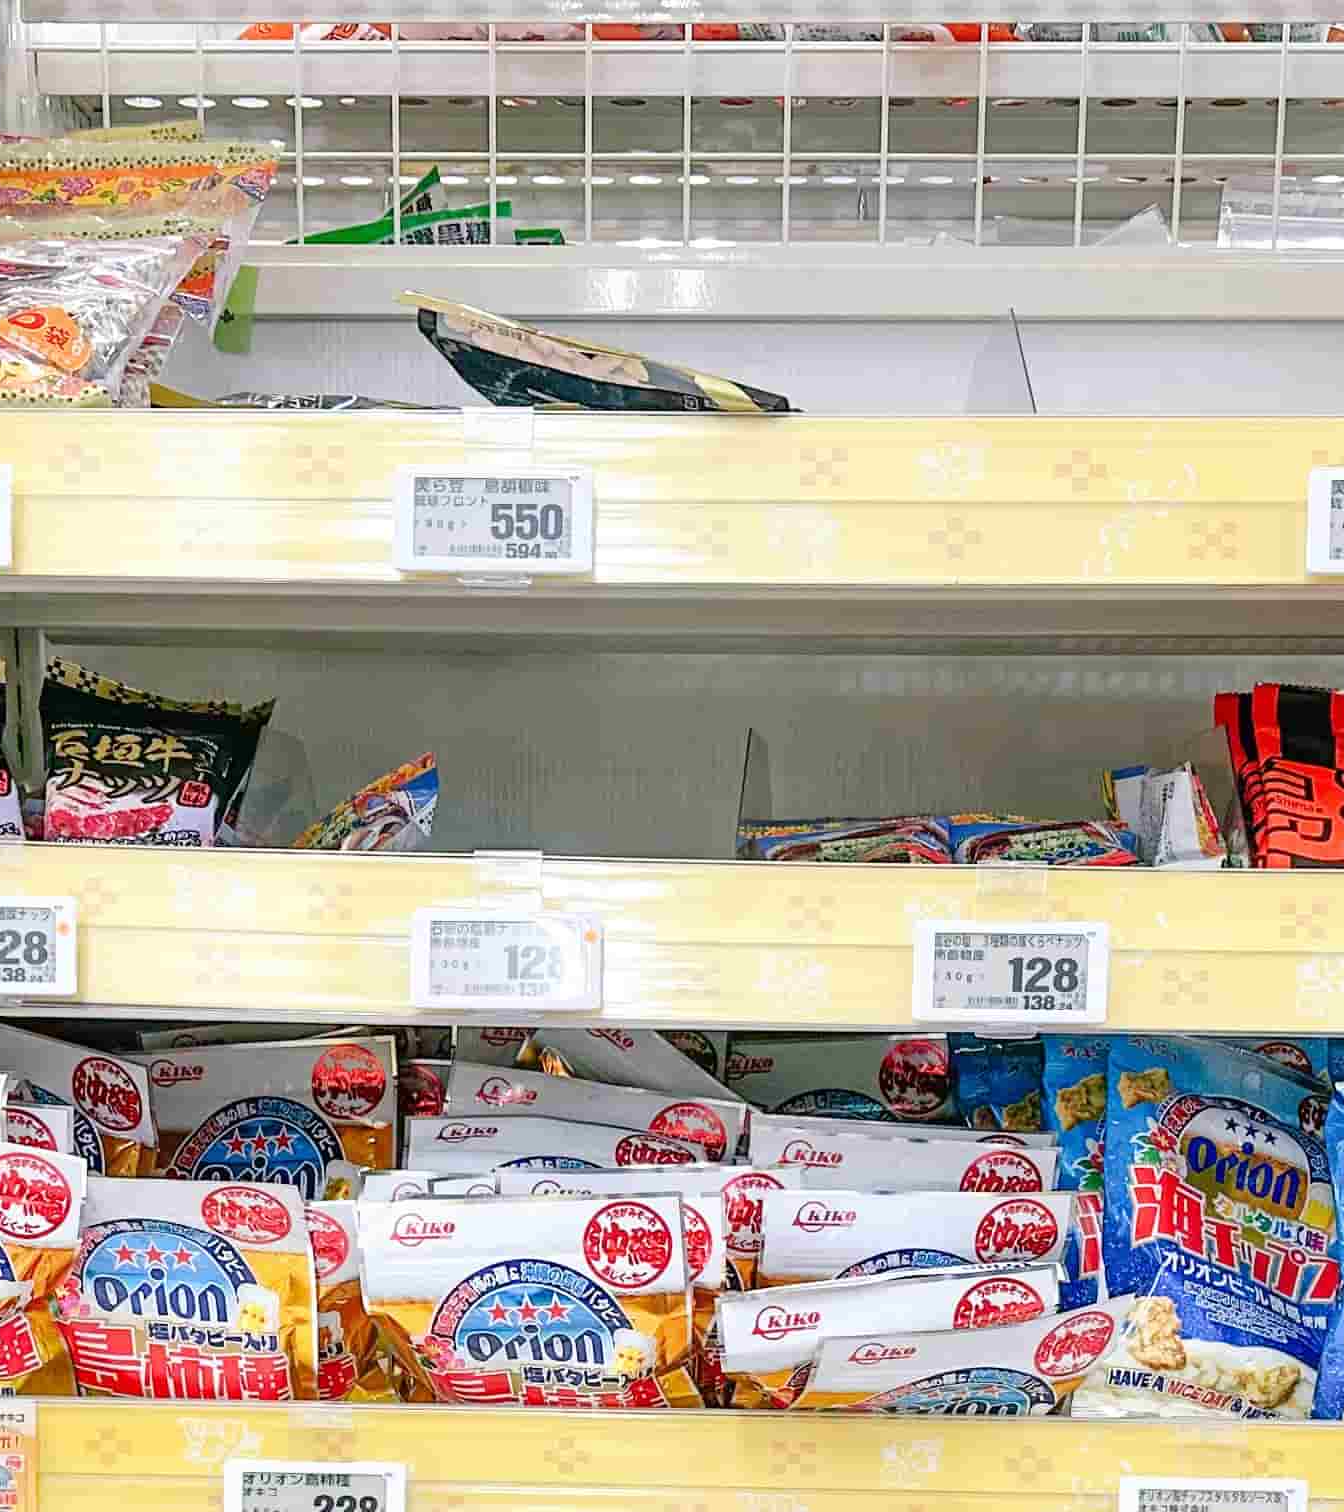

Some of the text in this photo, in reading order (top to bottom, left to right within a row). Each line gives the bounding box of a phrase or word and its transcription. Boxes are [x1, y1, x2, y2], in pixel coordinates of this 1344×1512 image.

[490, 503, 563, 541] 550
[49, 729, 192, 773] 石垣牛
[55, 762, 178, 804] ナッツ
[1008, 956, 1079, 993] 128
